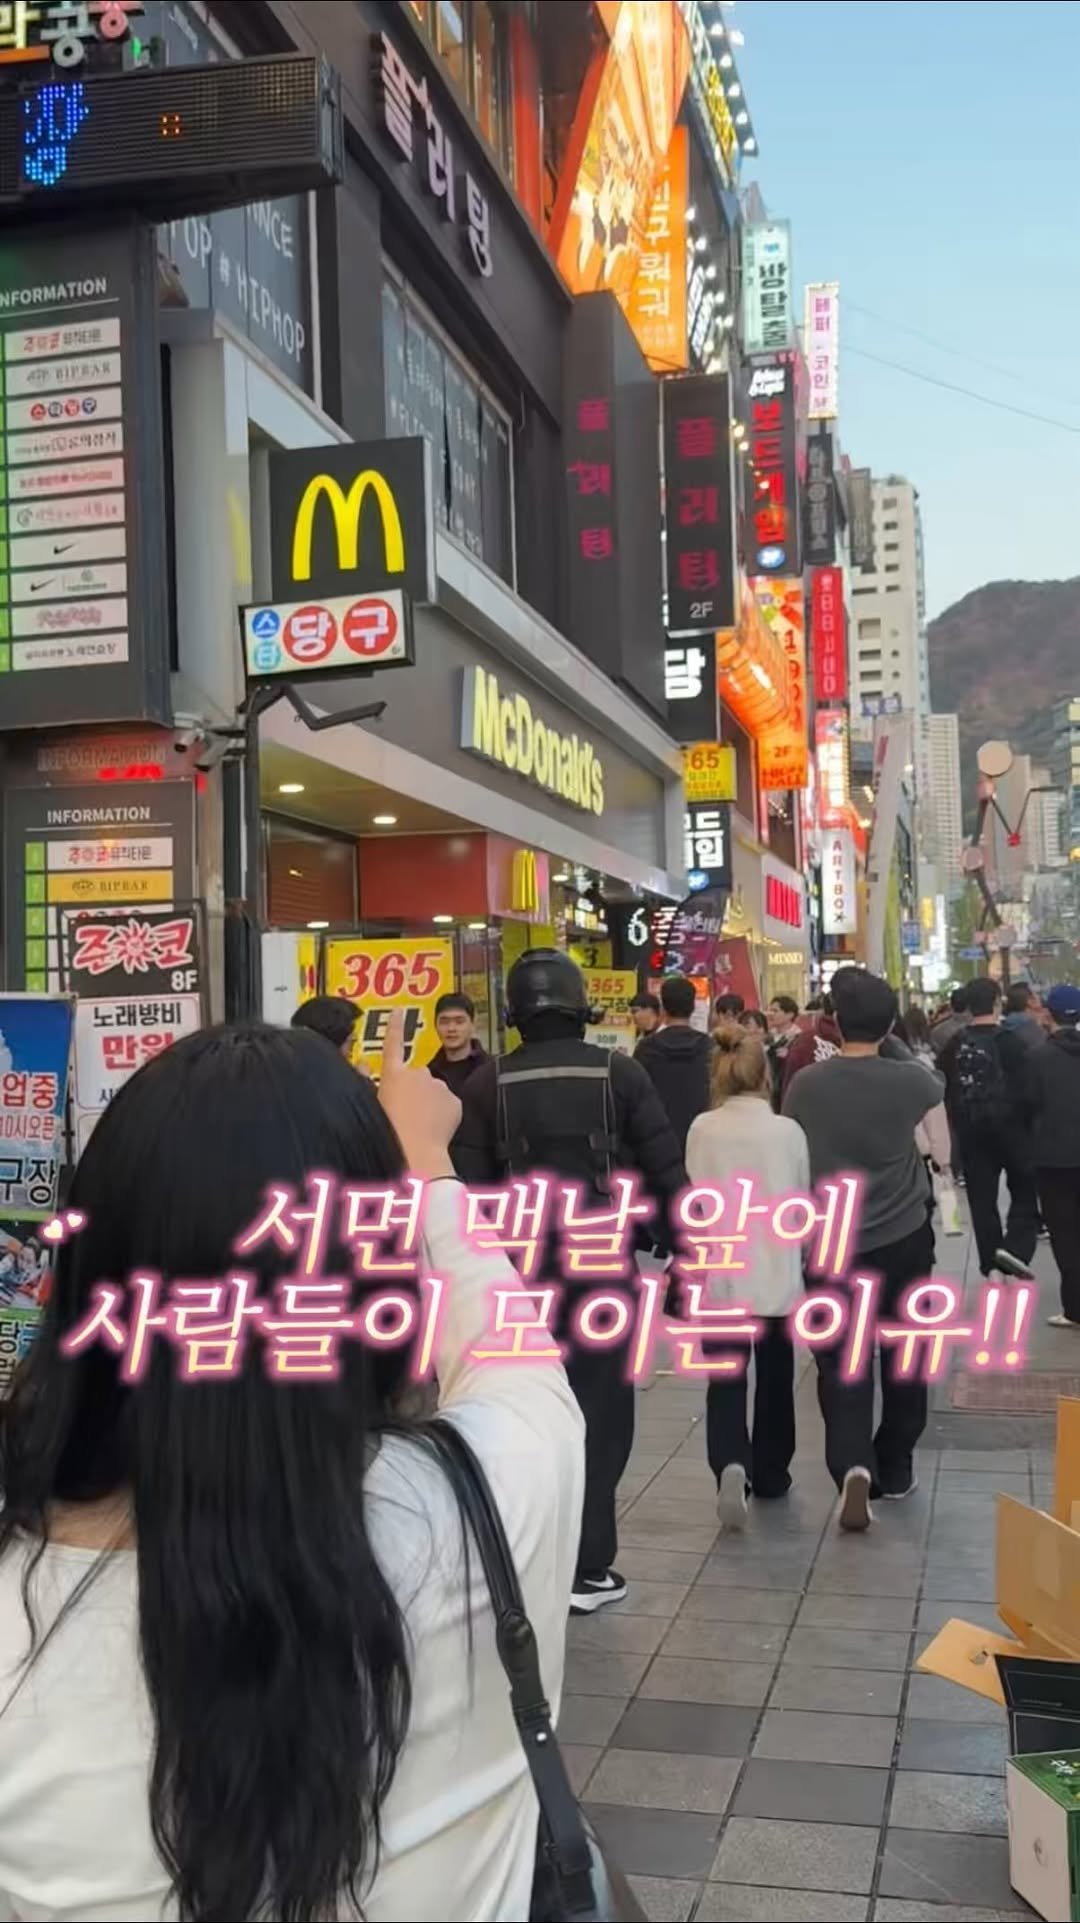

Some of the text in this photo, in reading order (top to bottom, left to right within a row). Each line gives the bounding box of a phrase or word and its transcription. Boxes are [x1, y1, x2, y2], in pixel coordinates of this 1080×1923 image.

[170, 216, 212, 268] OP
[236, 264, 306, 363] HIPHOP
[757, 262, 788, 347] 방탈출
[286, 602, 393, 660] 당구
[690, 602, 713, 618] 2F
[472, 664, 604, 816] McDonald's
[686, 750, 720, 770] 65
[47, 806, 151, 823] INFORMATION
[833, 840, 845, 922] ARTBOX
[171, 971, 197, 991] 8F
[339, 952, 444, 998] 365
[591, 978, 625, 993] 365
[93, 1002, 181, 1027] 노래방비
